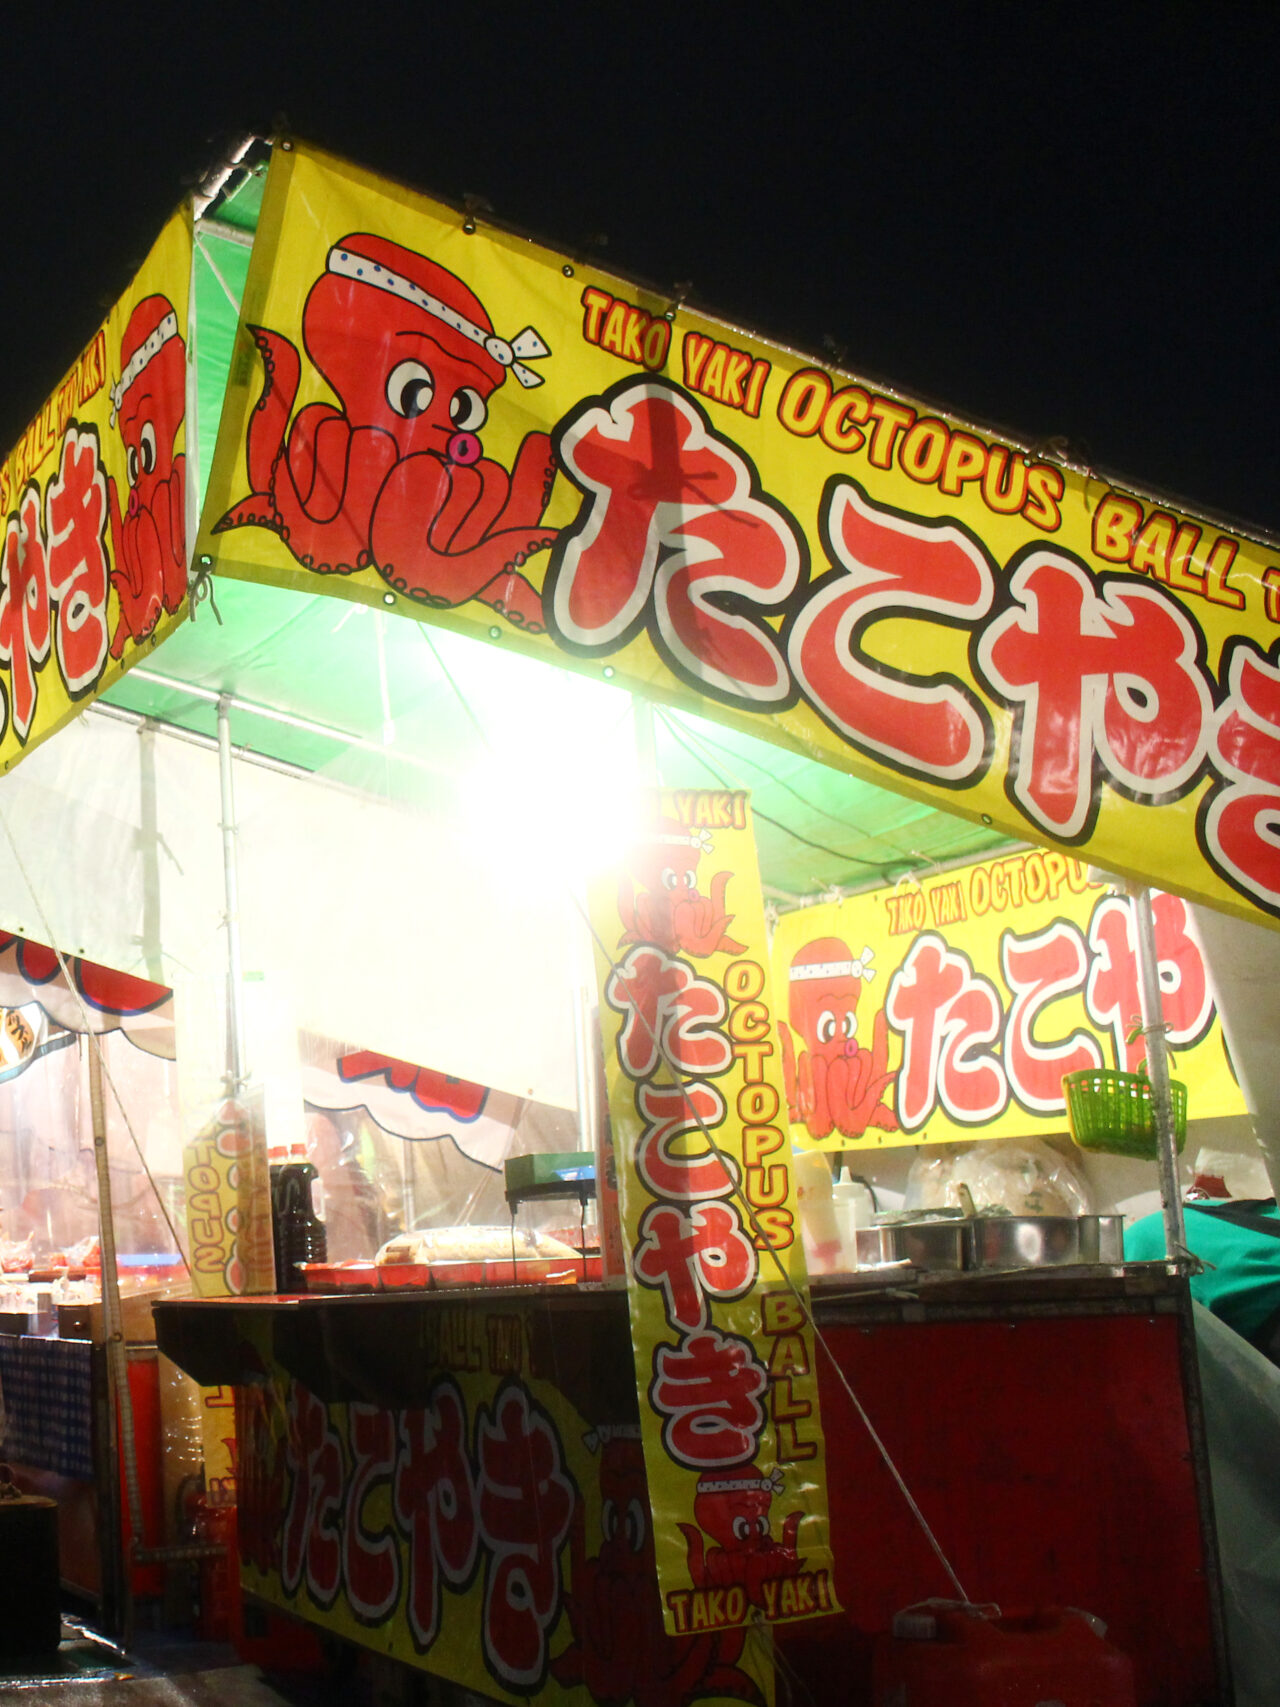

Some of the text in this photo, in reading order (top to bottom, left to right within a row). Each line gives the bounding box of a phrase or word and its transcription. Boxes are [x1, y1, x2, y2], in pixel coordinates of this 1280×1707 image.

[15, 397, 56, 493] BALL
[582, 285, 672, 372] TAKO
[683, 331, 770, 418] YAKI
[777, 366, 1064, 532] OCTOPUS
[1092, 494, 1246, 610] BALL
[674, 790, 750, 829] YAKI
[886, 851, 1106, 936] TAKO YAKI OCTOPU
[604, 941, 770, 1470] たこやき
[724, 959, 819, 1464] OCTOPUS BALL
[280, 1370, 579, 1696] たこやき
[667, 1569, 833, 1633] TAKO YAKI
